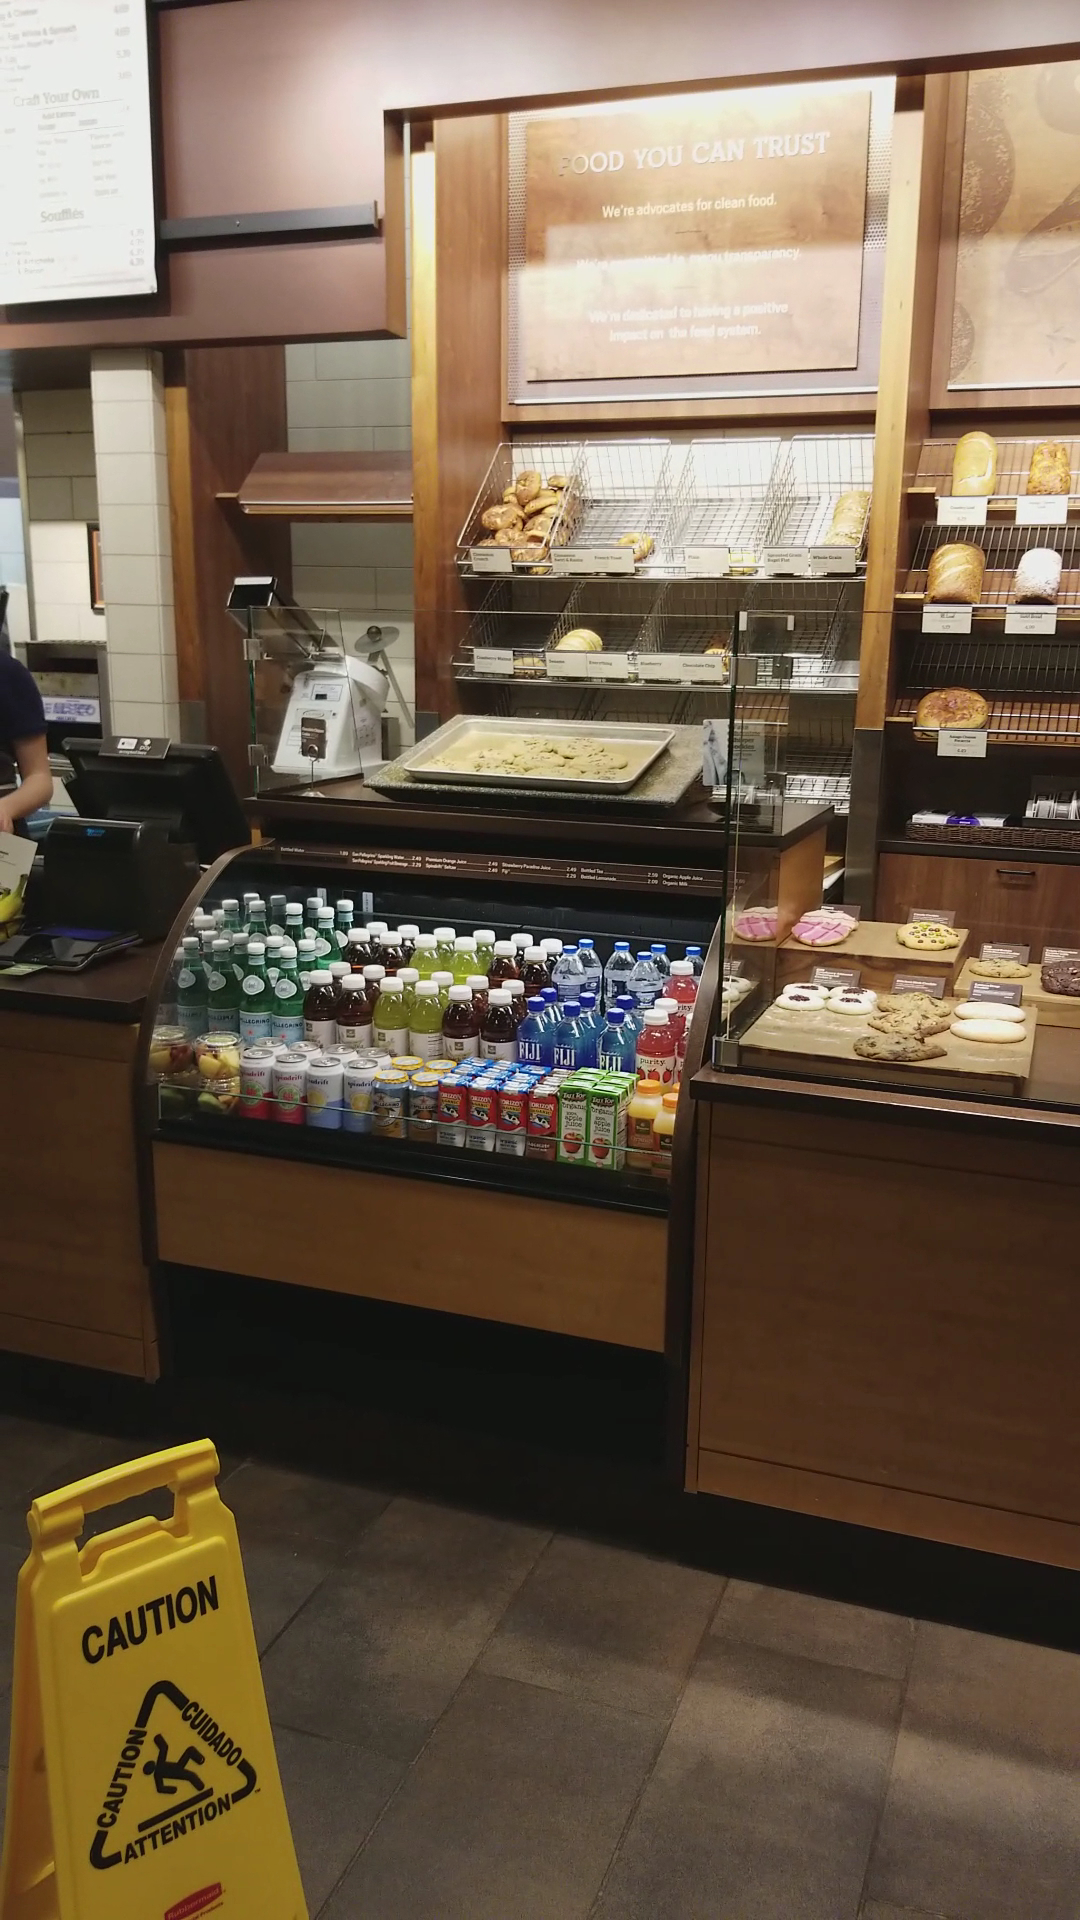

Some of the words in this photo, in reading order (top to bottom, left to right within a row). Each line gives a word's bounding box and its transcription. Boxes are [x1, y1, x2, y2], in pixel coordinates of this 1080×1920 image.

[13, 94, 40, 107] Craft
[42, 91, 70, 105] Your
[71, 88, 100, 101] Own
[633, 144, 683, 170] YOU
[691, 138, 746, 165] CAN
[753, 130, 830, 160] TRUST
[602, 204, 635, 219] We're
[636, 202, 694, 216] advocates
[696, 198, 712, 212] for
[714, 196, 746, 210] clean
[748, 192, 777, 208] food.
[724, 247, 801, 263] transparency.
[589, 310, 621, 324] We're
[622, 306, 678, 322] dedicated
[680, 306, 692, 319] to
[694, 303, 731, 320] having
[742, 301, 788, 317] positive
[650, 328, 664, 340] on
[668, 326, 687, 339] the
[689, 324, 715, 339] food
[717, 323, 761, 339] system.
[678, 1004, 692, 1012] rity.
[519, 1041, 541, 1060] FIJI
[554, 1047, 576, 1067] FIJI
[600, 1054, 622, 1072] FIJI
[441, 1092, 462, 1100] ORIZON
[471, 1095, 492, 1104] ORIZON
[502, 1099, 524, 1107] ORIZON
[531, 1103, 554, 1111] ORIZON
[562, 1101, 587, 1110] organic
[591, 1106, 615, 1115] organic
[594, 1120, 611, 1128] apple
[81, 1576, 219, 1664] CAUTION
[181, 1701, 242, 1766] CUIDADO
[97, 1727, 147, 1828] CAUTION
[124, 1793, 230, 1864] ATTENTION
[167, 1887, 220, 1920] Rubbermaid
